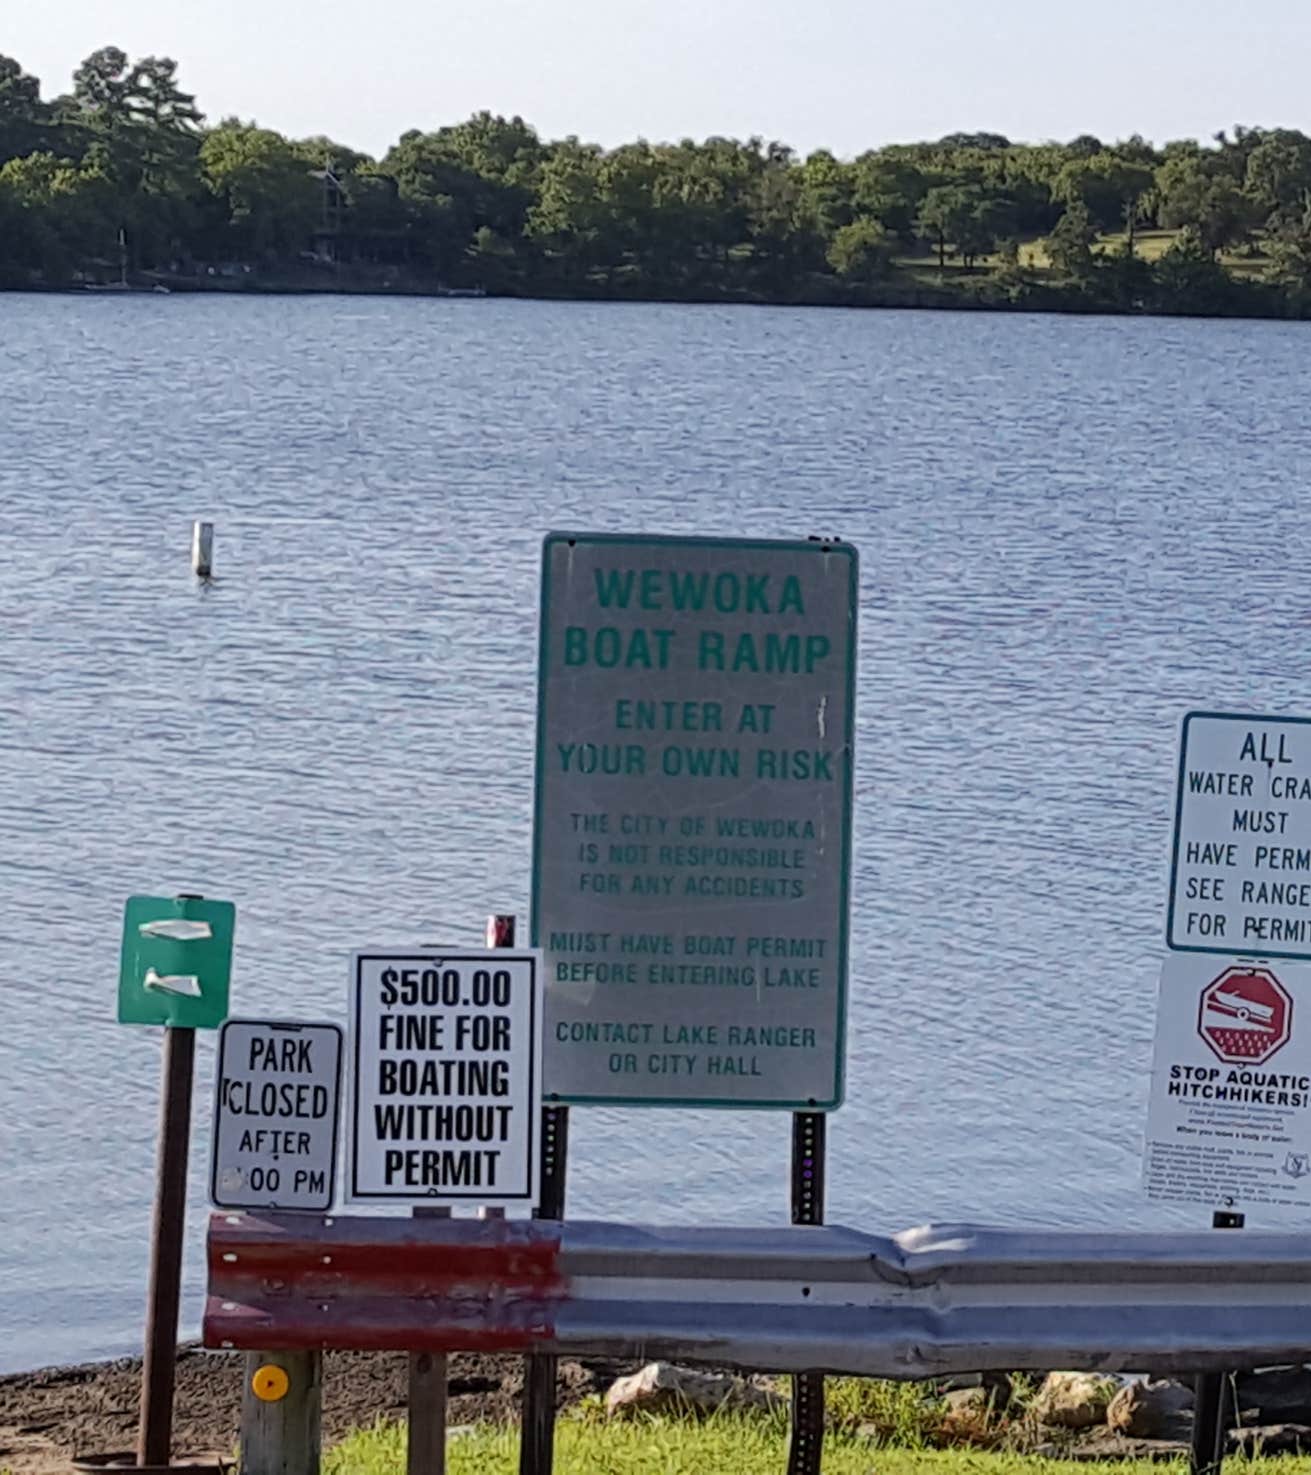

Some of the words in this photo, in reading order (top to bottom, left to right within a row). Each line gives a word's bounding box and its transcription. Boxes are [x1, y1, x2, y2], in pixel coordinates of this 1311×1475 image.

[594, 569, 805, 615] WEWOKA
[564, 627, 676, 669] BOAT
[698, 631, 831, 674] RAMP
[616, 699, 722, 732] ENTER
[738, 704, 776, 733] AT
[1240, 732, 1292, 763] ALL
[557, 743, 646, 774] YOUR
[663, 746, 740, 776] OWN
[757, 750, 832, 780] RISK
[1189, 771, 1254, 797] WATER
[571, 813, 609, 833] THE
[620, 815, 667, 836] CITY
[680, 816, 705, 837] OF
[717, 818, 816, 840] WEWOKA
[1232, 809, 1289, 834] MUST
[580, 843, 598, 864] IS
[609, 844, 651, 865] NOT
[659, 845, 806, 869] RESPONSIBLE
[1186, 842, 1238, 867] HAVE
[580, 873, 621, 894] FOR
[631, 875, 675, 896] ANY
[685, 876, 804, 899] ACCIDENTS
[1186, 877, 1225, 901] SEE
[1187, 912, 1227, 937] FOR
[550, 932, 611, 954] MUST
[621, 934, 673, 955] HAVE
[684, 935, 737, 956] BOAT
[747, 937, 828, 958] PERMIT
[556, 962, 637, 984] BEFORE
[649, 964, 757, 987] ENTERING
[764, 968, 820, 988] LAKE
[380, 966, 511, 1011] $500.00
[379, 1015, 444, 1051] FINE
[456, 1015, 511, 1051] FOR
[556, 1022, 654, 1046] CONTACT
[663, 1024, 718, 1046] LAKE
[728, 1026, 816, 1048] RANGER
[249, 1037, 313, 1073] PARK
[609, 1053, 637, 1074] OR
[648, 1054, 697, 1076] CITY
[707, 1056, 762, 1077] HALL
[379, 1059, 510, 1097] BOATING
[1170, 1065, 1220, 1082] STOP
[1227, 1071, 1310, 1091] AQUATIC
[228, 1080, 328, 1119] CLOSED
[1168, 1081, 1309, 1108] HITCHHIKERS!
[374, 1104, 514, 1142] WITHOUT
[239, 1129, 311, 1155] AFTER
[385, 1150, 501, 1186] PERMIT
[293, 1170, 325, 1194] PM
